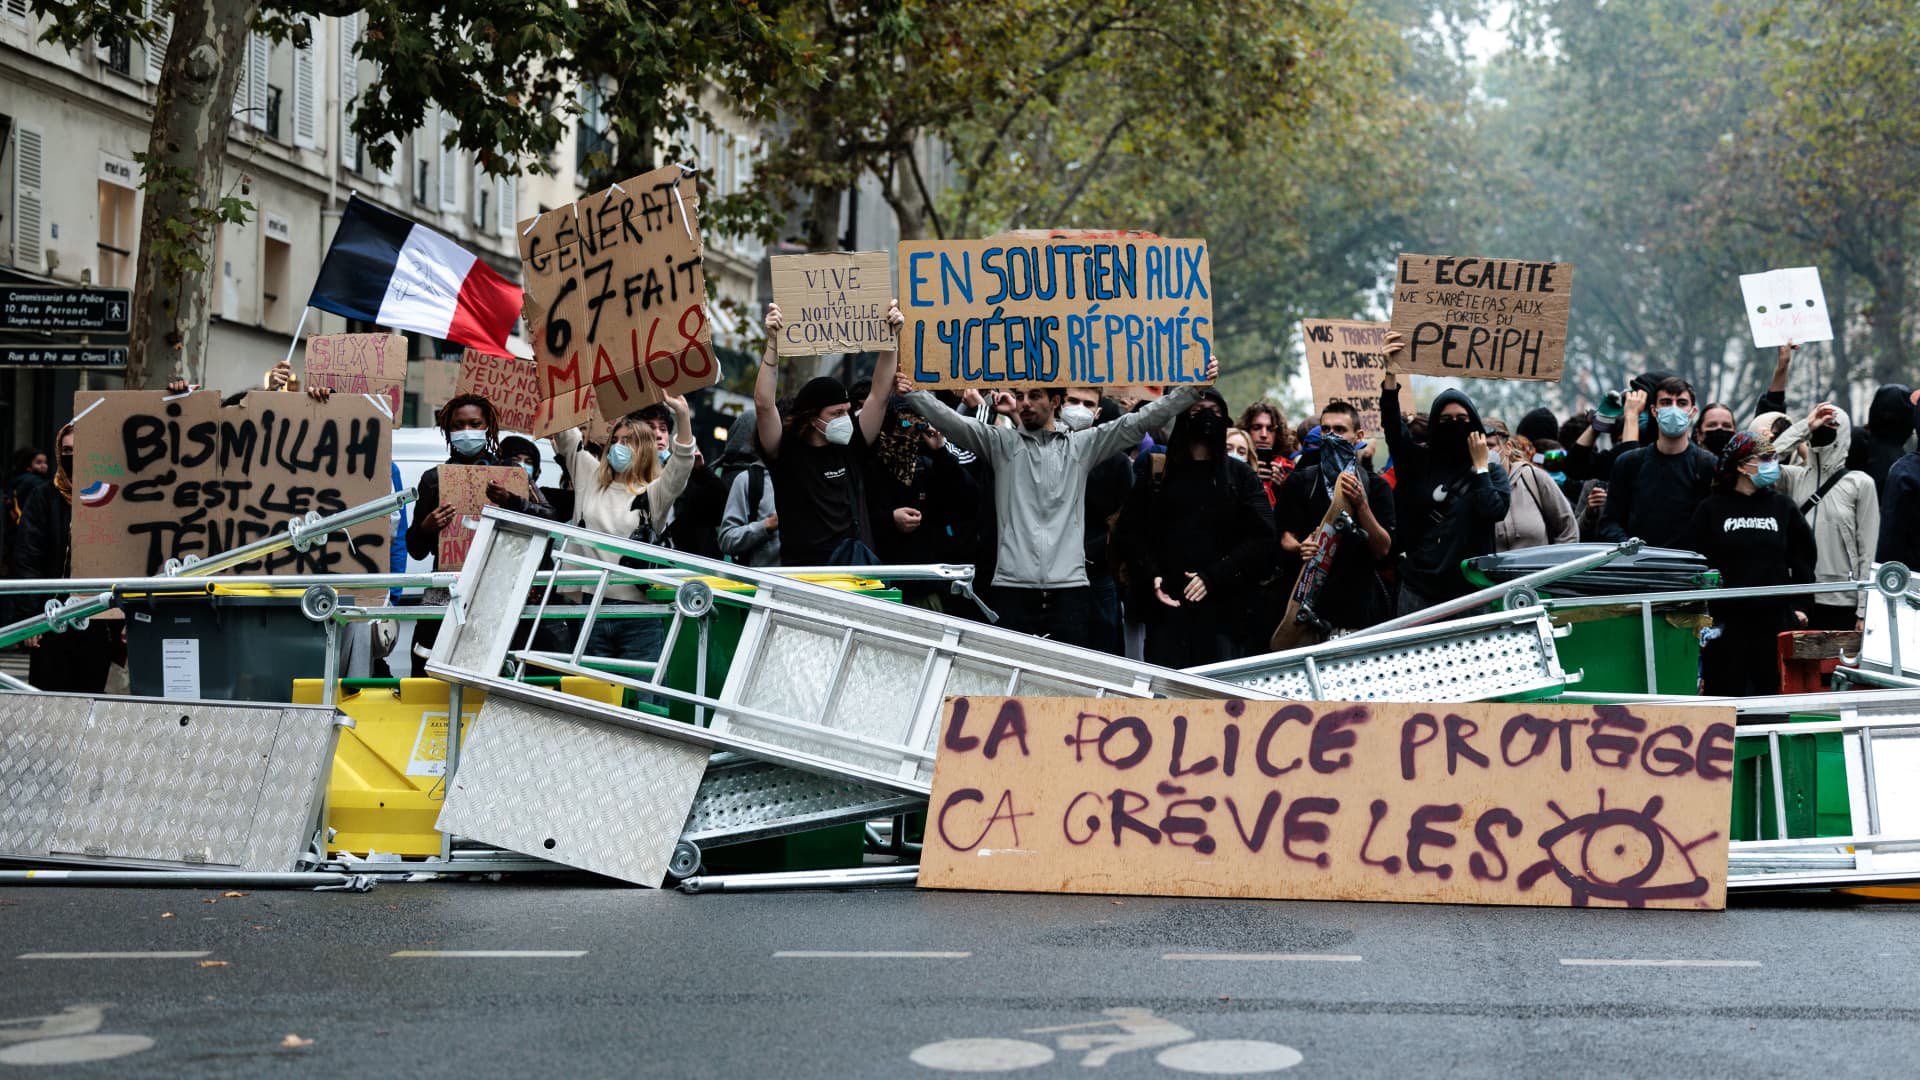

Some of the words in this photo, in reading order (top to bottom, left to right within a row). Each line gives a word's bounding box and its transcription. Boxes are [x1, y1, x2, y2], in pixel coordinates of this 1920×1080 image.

[803, 267, 861, 290] VIVE
[910, 251, 974, 307] EN
[1146, 246, 1209, 301] AUX
[9, 292, 64, 303] Commissariat
[66, 294, 77, 303] de
[80, 293, 105, 304] Police
[545, 259, 617, 357] 67
[826, 291, 847, 307] LA
[1400, 291, 1419, 304] NE
[1482, 296, 1507, 313] PAS
[1513, 300, 1544, 315] AUX
[20, 304, 40, 314] Rue
[45, 305, 88, 315] Perronet
[801, 304, 880, 321] NOUVELLE
[1445, 309, 1489, 325] PORTES
[1496, 313, 1513, 326] DU
[786, 320, 895, 344] COMMUNE!
[1306, 325, 1334, 343] VOUS
[914, 307, 1059, 383] LYCÉENS
[8, 351, 25, 361] Rue
[29, 351, 40, 361] du
[43, 351, 58, 361] Pré
[61, 352, 76, 361] aux
[81, 352, 107, 362] Clercs
[307, 335, 389, 377] SEXY
[466, 351, 498, 368] NOS
[1322, 351, 1339, 368] LA
[1341, 351, 1385, 369] JEUNESS
[122, 469, 253, 510] C'EST
[260, 483, 347, 515] LES
[1723, 517, 1778, 532] MAYHEM
[944, 698, 1030, 760] LA
[937, 788, 1035, 852] CA
[1358, 799, 1524, 882] LES
